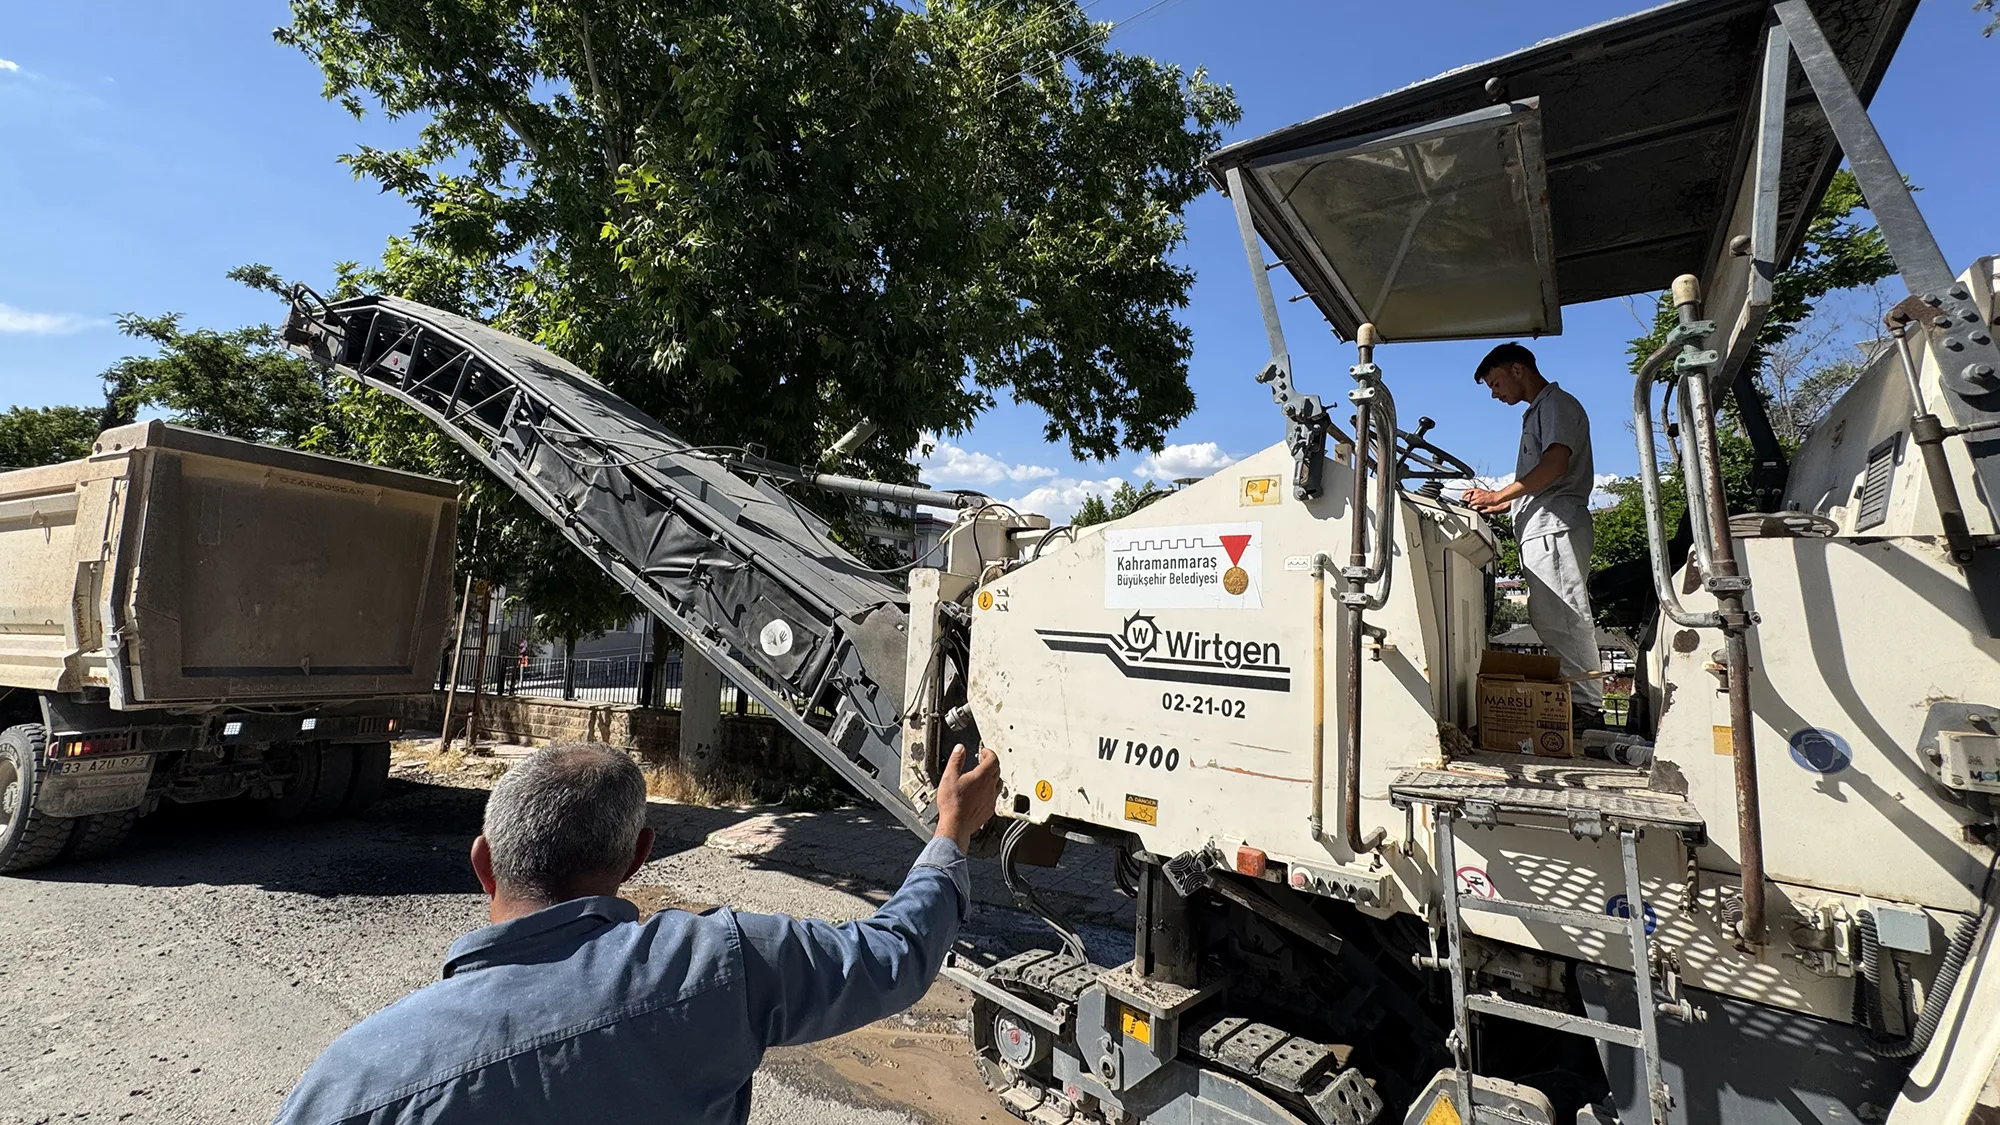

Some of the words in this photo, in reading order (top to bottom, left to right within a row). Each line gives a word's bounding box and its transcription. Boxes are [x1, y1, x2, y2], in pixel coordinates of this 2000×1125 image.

[1117, 556, 1217, 571] Kahramanmaraş
[1117, 573, 1167, 588] Büyükşehir
[1169, 572, 1218, 587] Belediyesi
[1132, 627, 1149, 645] W
[1165, 630, 1280, 669] Wirtgen
[1162, 692, 1246, 719] 02-21-02
[1484, 695, 1533, 708] MARSU
[1098, 736, 1119, 761] W
[1124, 741, 1180, 772] 1900
[62, 763, 81, 774] 33
[88, 758, 116, 771] AZU
[121, 756, 145, 767] 973
